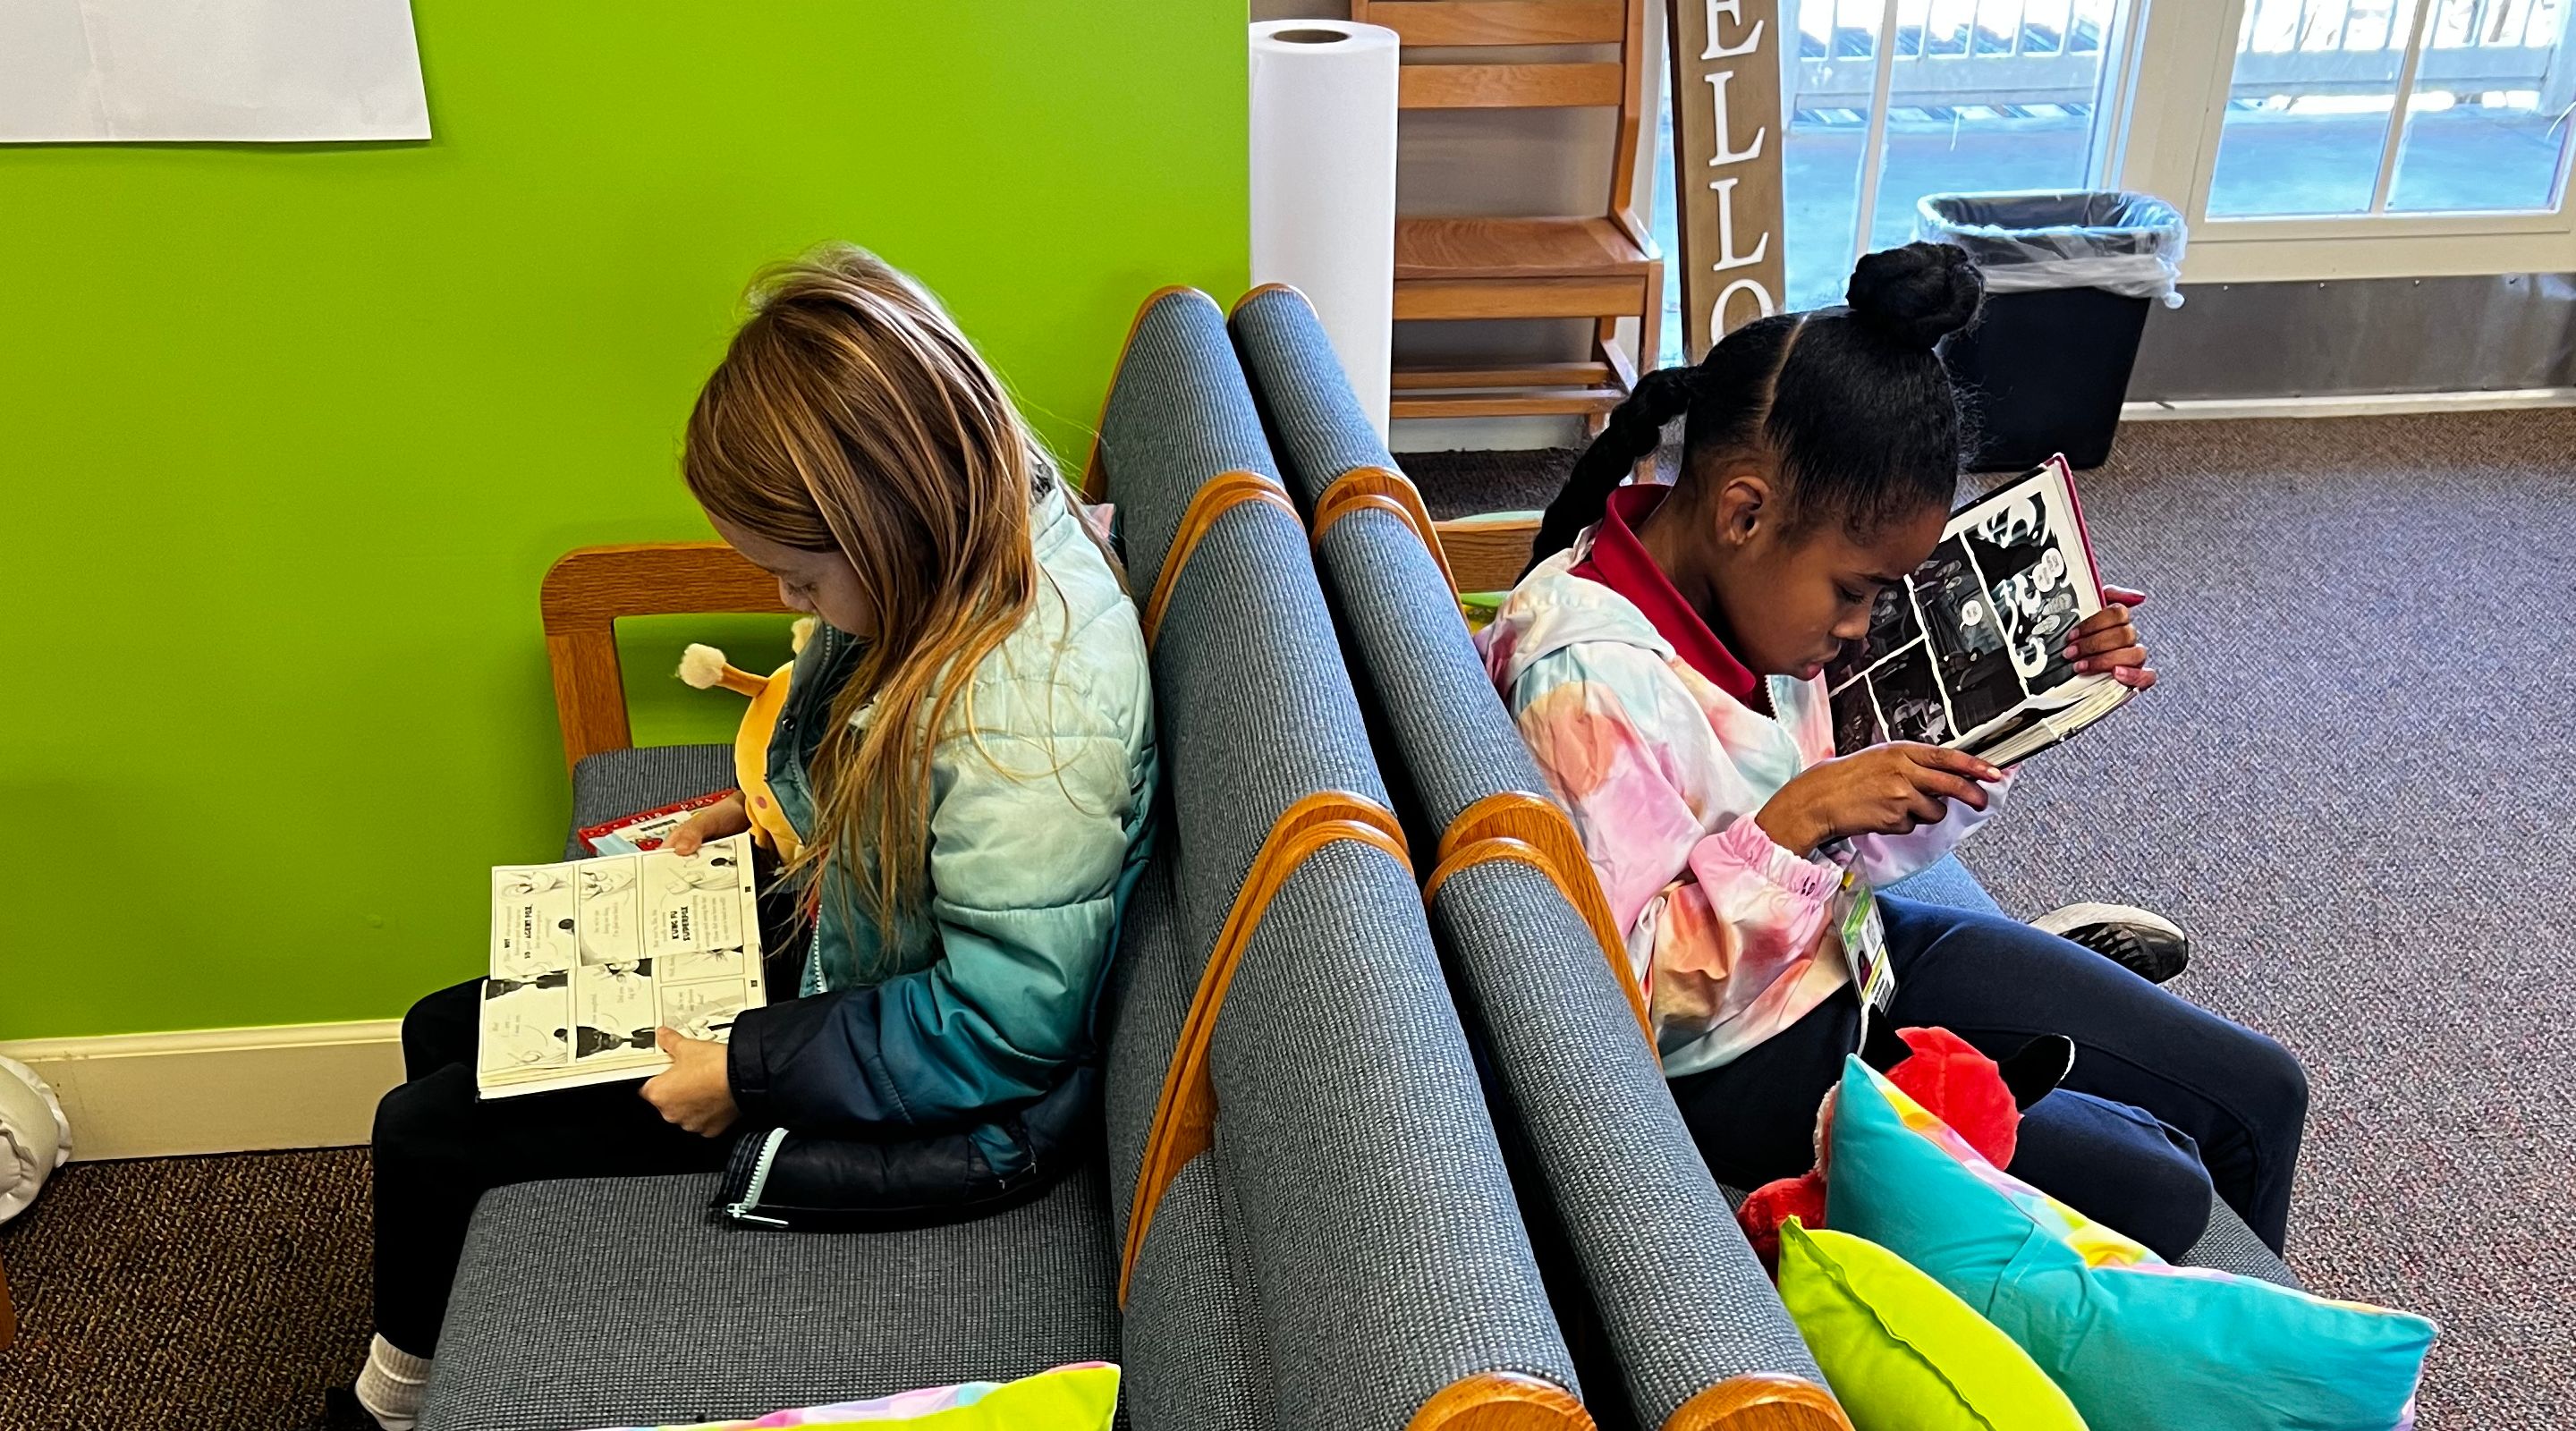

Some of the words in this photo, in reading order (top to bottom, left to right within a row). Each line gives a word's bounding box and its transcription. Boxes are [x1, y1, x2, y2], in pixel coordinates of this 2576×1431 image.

[670, 910, 678, 919] FU
[681, 906, 691, 941] SUPERFOX
[671, 920, 679, 939] KUNG
